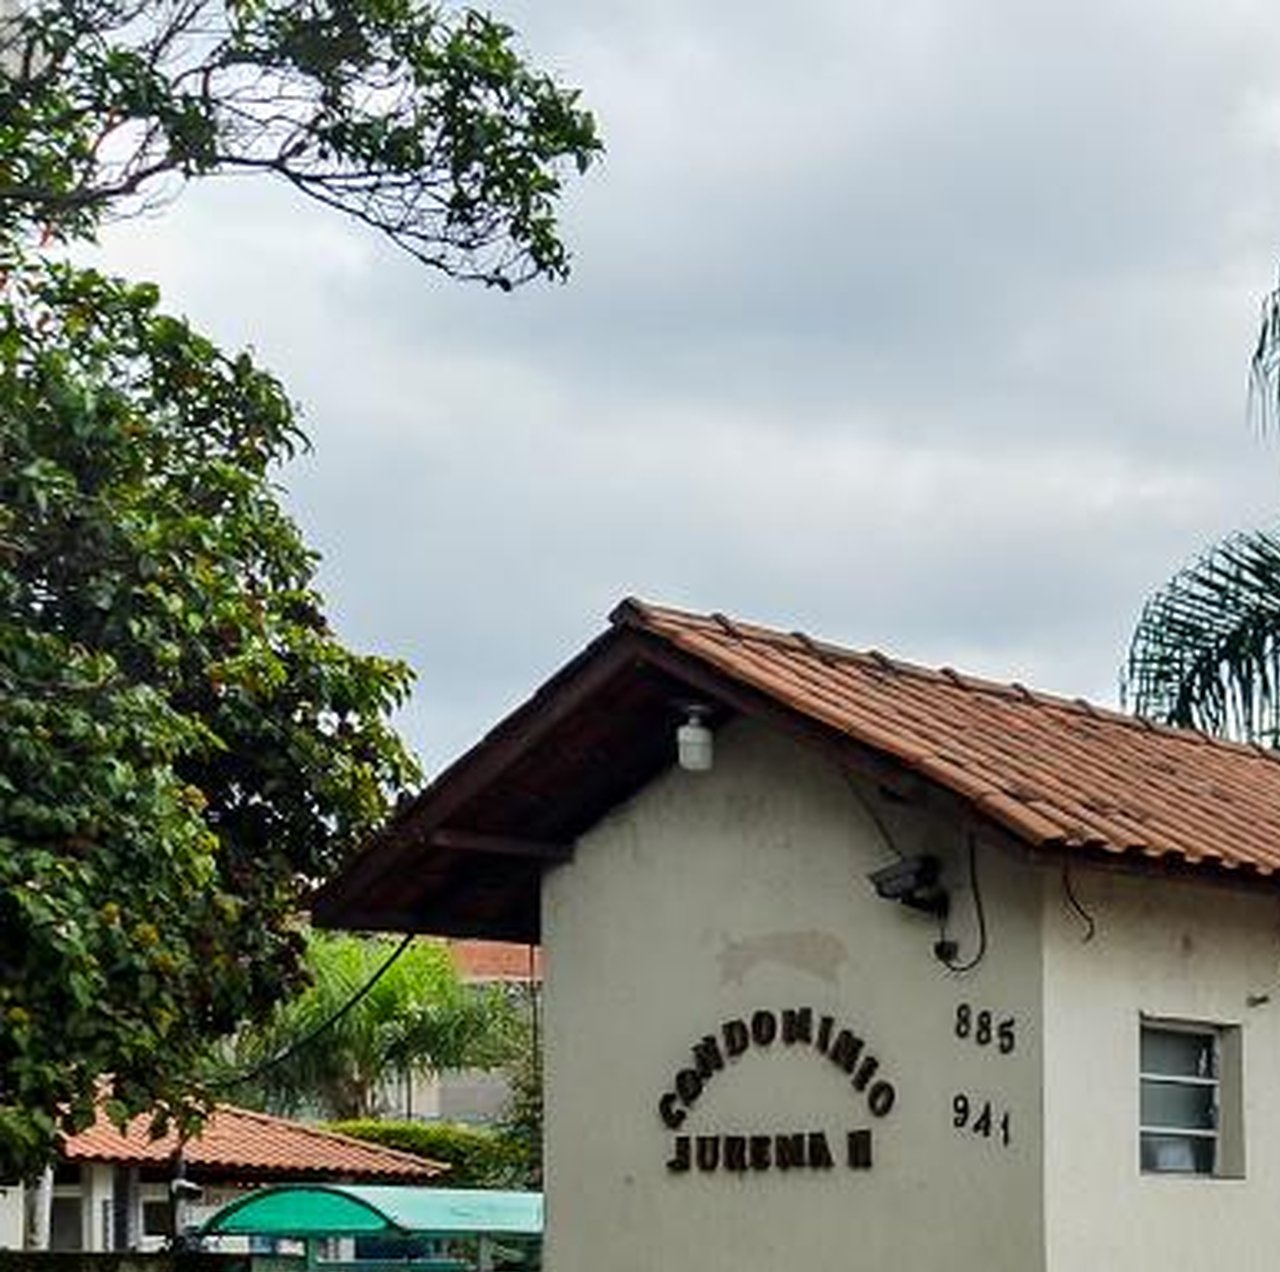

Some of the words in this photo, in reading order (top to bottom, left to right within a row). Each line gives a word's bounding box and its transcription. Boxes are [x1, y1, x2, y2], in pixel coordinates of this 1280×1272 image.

[955, 1003, 1015, 1055] 885
[658, 1007, 895, 1129] CONDOMINIO
[953, 1094, 1010, 1148] 941
[666, 1131, 834, 1171] JUREMA
